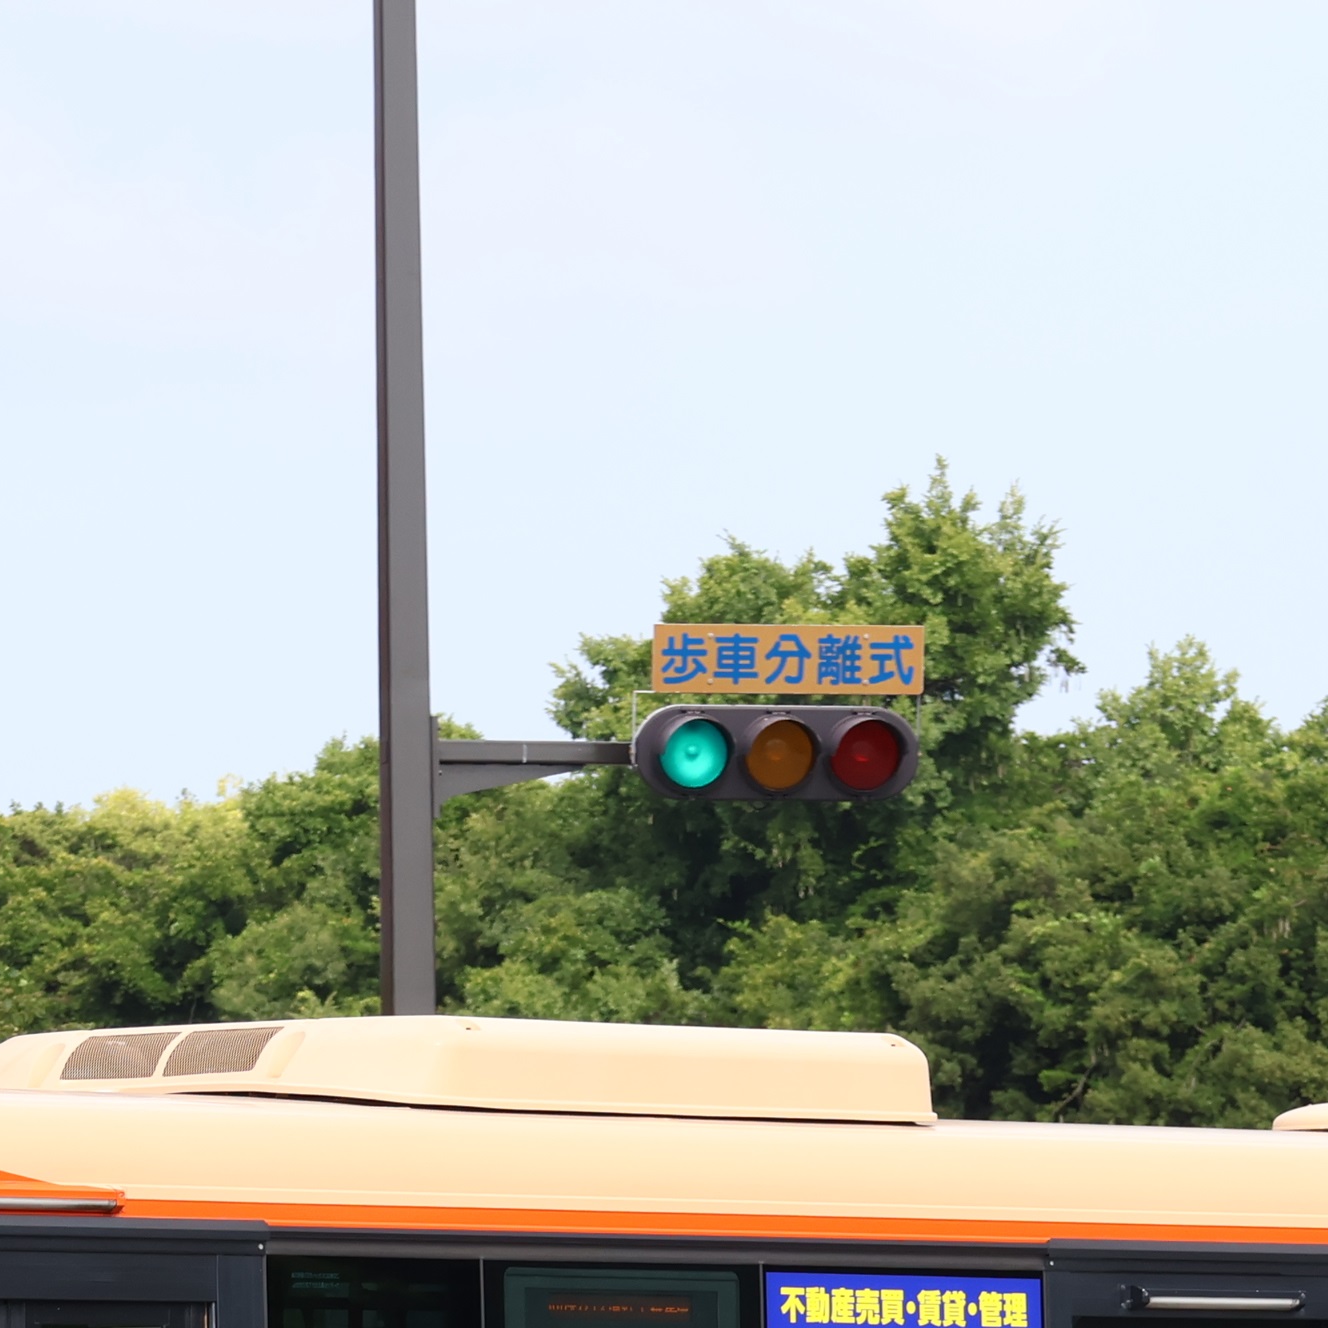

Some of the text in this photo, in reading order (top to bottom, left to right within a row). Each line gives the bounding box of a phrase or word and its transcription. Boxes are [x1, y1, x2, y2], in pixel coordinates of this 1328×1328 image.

[661, 633, 915, 685] 歩車分離式
[780, 1287, 1028, 1328] 不動産売買・賃貸・管理
